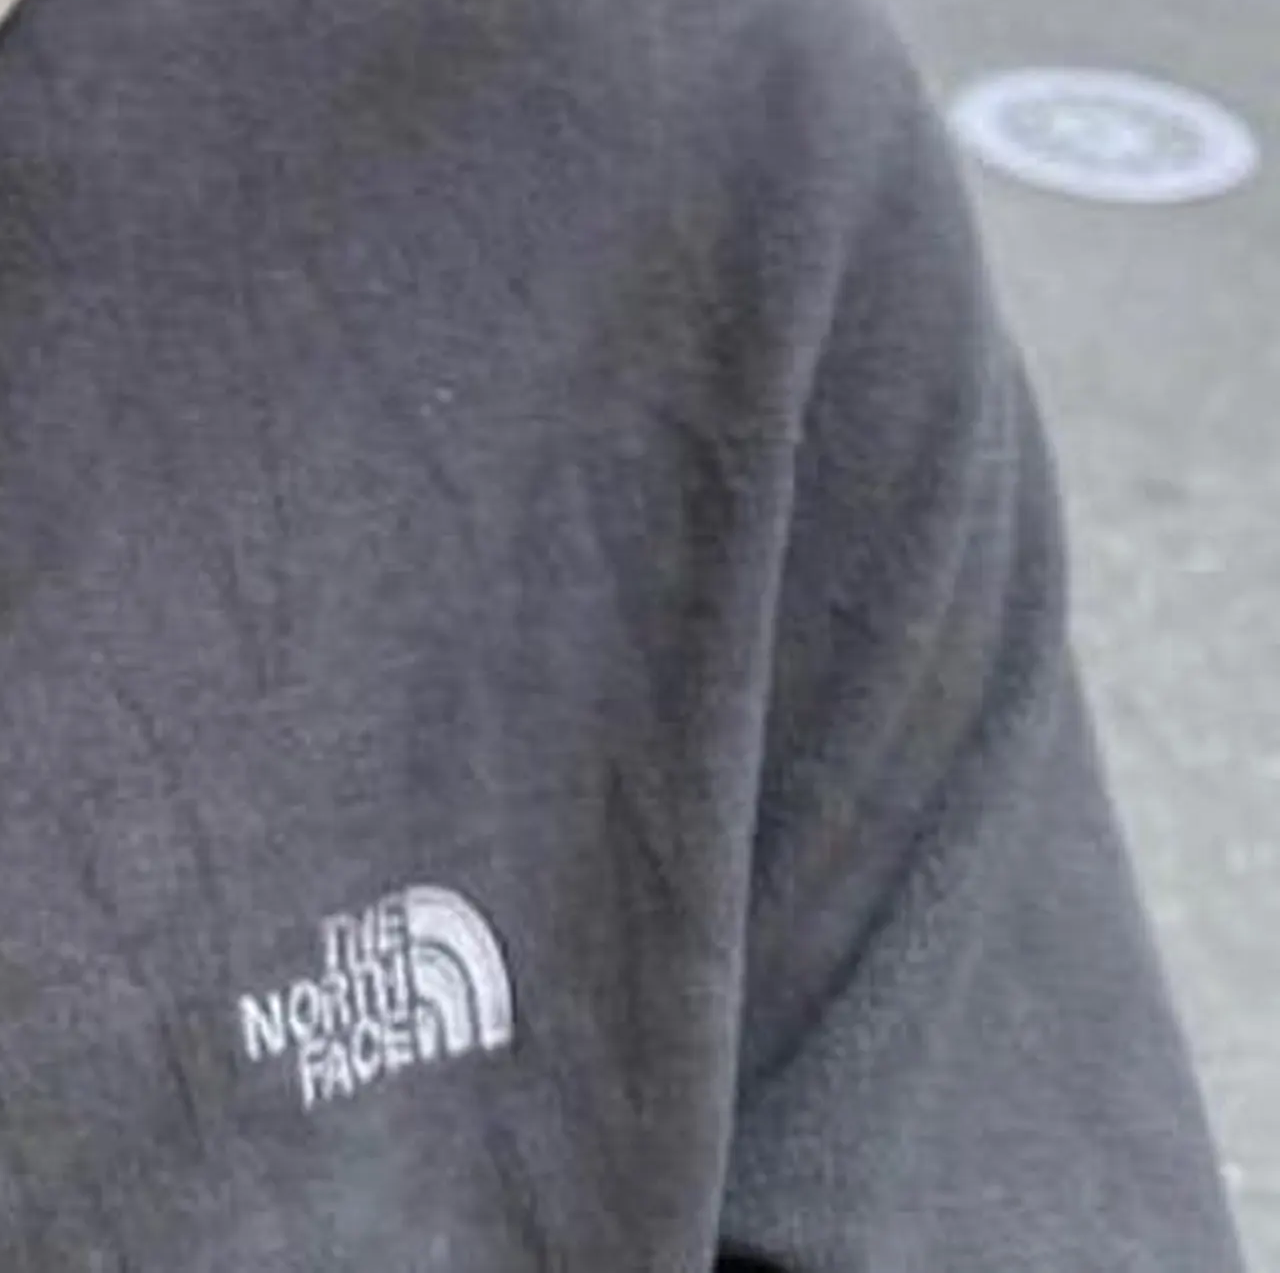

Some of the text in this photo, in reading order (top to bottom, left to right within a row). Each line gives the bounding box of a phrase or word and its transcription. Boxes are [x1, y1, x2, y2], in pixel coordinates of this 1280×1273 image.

[322, 891, 406, 968] THE
[240, 951, 409, 1061] NORTH
[298, 1018, 414, 1109] FACE
